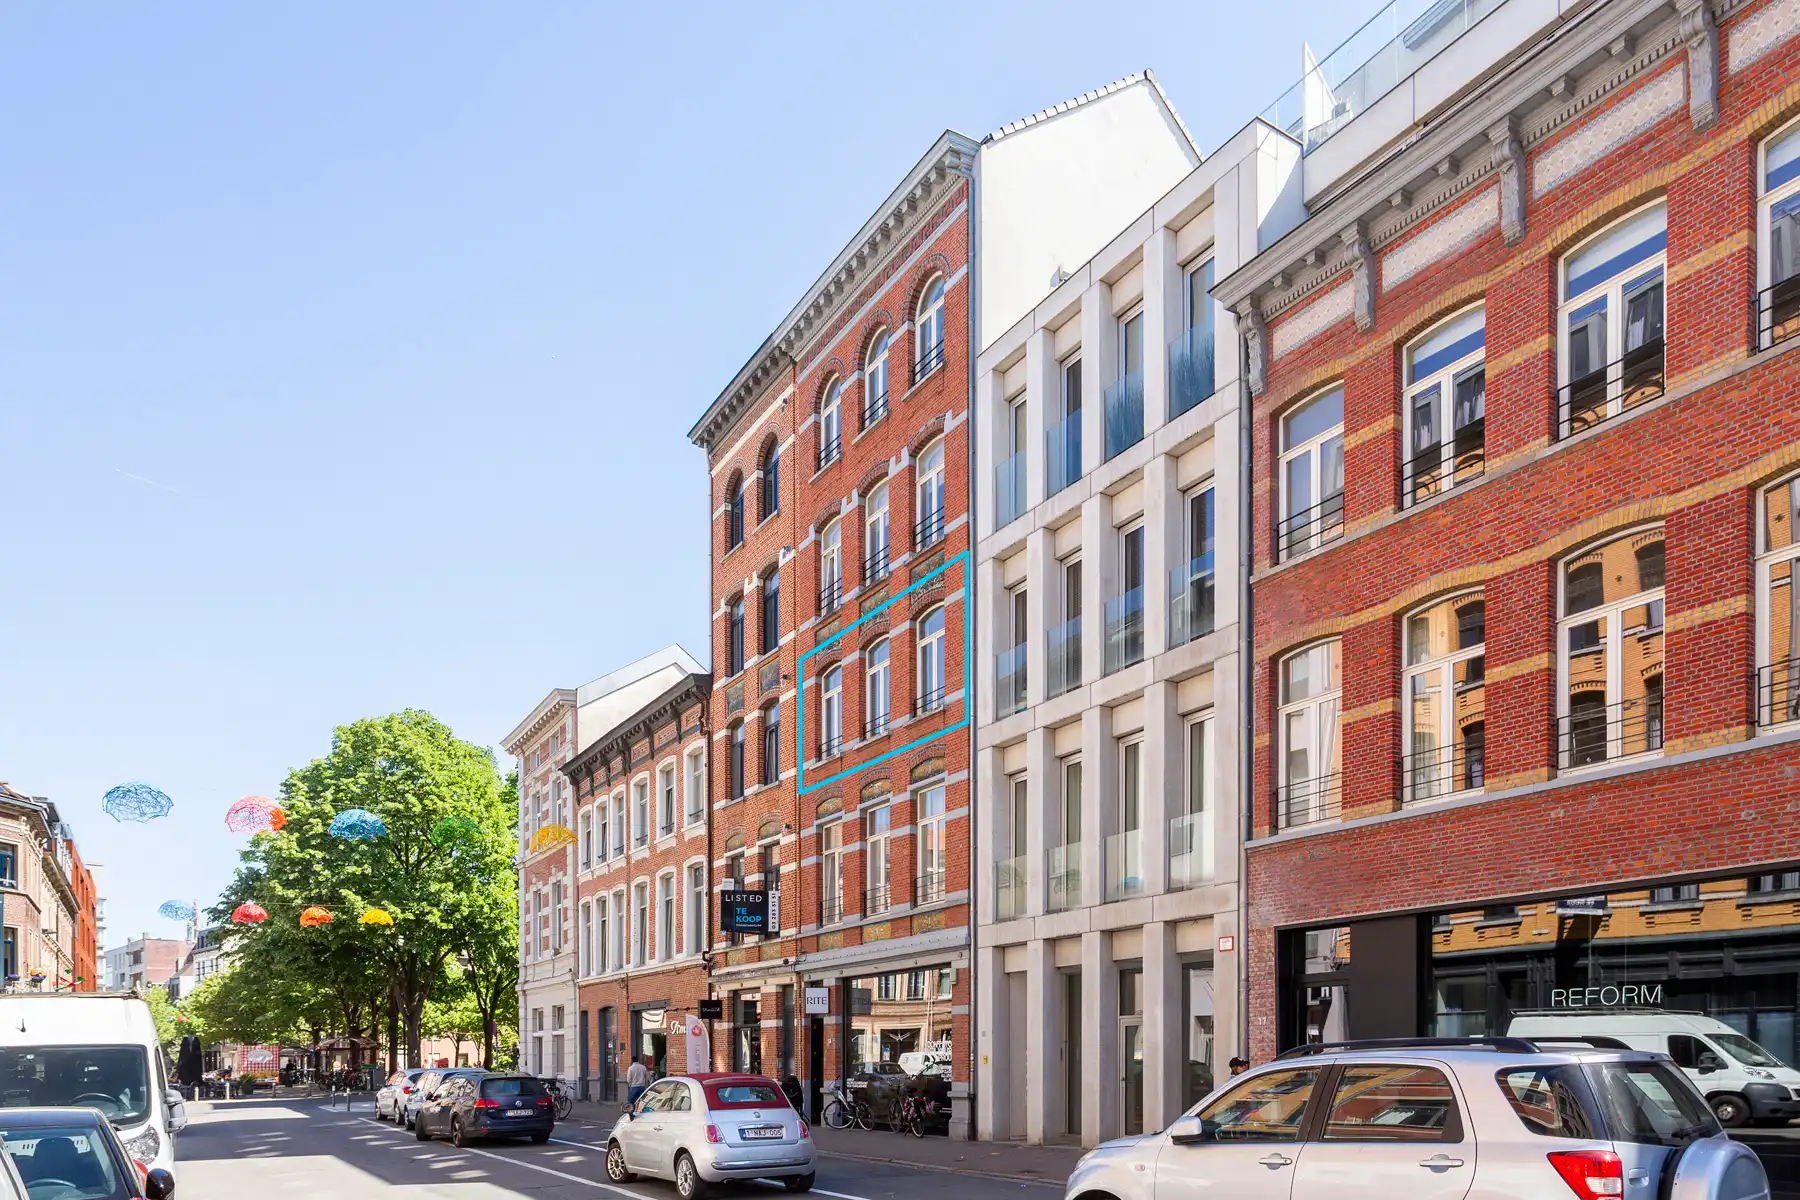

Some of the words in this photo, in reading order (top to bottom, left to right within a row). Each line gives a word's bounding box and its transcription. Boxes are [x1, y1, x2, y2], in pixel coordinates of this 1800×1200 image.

[725, 894, 762, 902] LISTED
[735, 907, 748, 915] TE
[1551, 984, 1662, 1007] REFORM
[806, 996, 828, 1005] RITE
